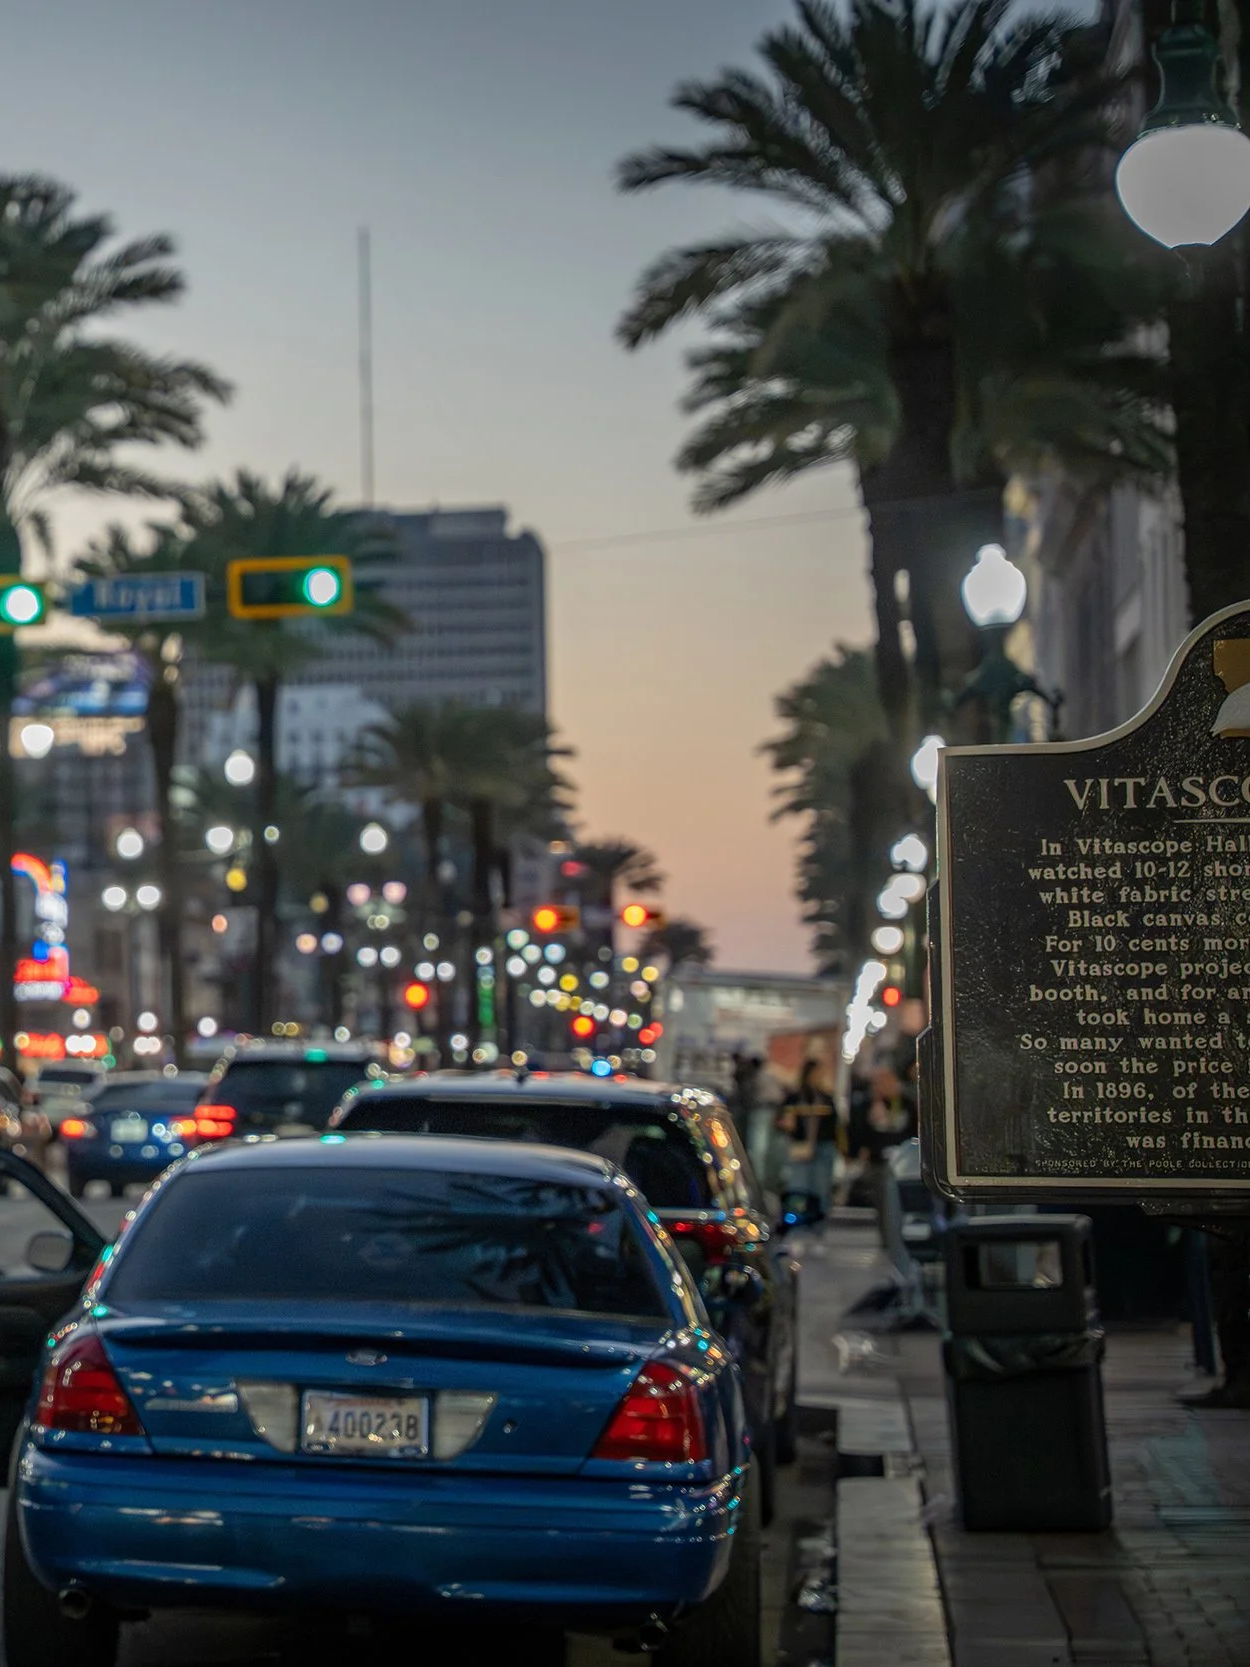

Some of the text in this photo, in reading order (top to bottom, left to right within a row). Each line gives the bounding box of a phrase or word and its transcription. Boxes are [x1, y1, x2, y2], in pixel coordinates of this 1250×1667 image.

[1064, 775, 1250, 810] VITASC
[1041, 838, 1062, 856] In
[1078, 837, 1192, 857] Vitascope
[1028, 862, 1122, 880] watched
[1135, 860, 1191, 878] 10-12
[1039, 887, 1104, 904] white
[1120, 886, 1191, 903] fabric
[1068, 910, 1131, 927] Black
[1143, 912, 1221, 926] canvas
[1046, 935, 1083, 952] For
[1095, 934, 1116, 951] 10
[1128, 934, 1190, 951] cents
[1051, 959, 1168, 979] Vitascope
[1029, 985, 1108, 1002] booth,
[1126, 984, 1168, 1000] and
[1180, 983, 1216, 1000] for
[1076, 1008, 1131, 1025] took
[1143, 1007, 1207, 1024] home
[1218, 1012, 1231, 1024] a
[1020, 1034, 1048, 1050] So
[1060, 1036, 1123, 1052] many
[1138, 1032, 1223, 1049] wanted
[1054, 1061, 1108, 1074] soon
[1120, 1057, 1159, 1074] the
[1173, 1057, 1234, 1077] price
[1063, 1082, 1085, 1099] In
[1096, 1082, 1155, 1100] 1896,
[1172, 1082, 1198, 1098] of
[1047, 1107, 1172, 1123] territories
[1186, 1107, 1209, 1123] in
[1126, 1135, 1166, 1149] was
[1122, 1160, 1142, 1168] THE
